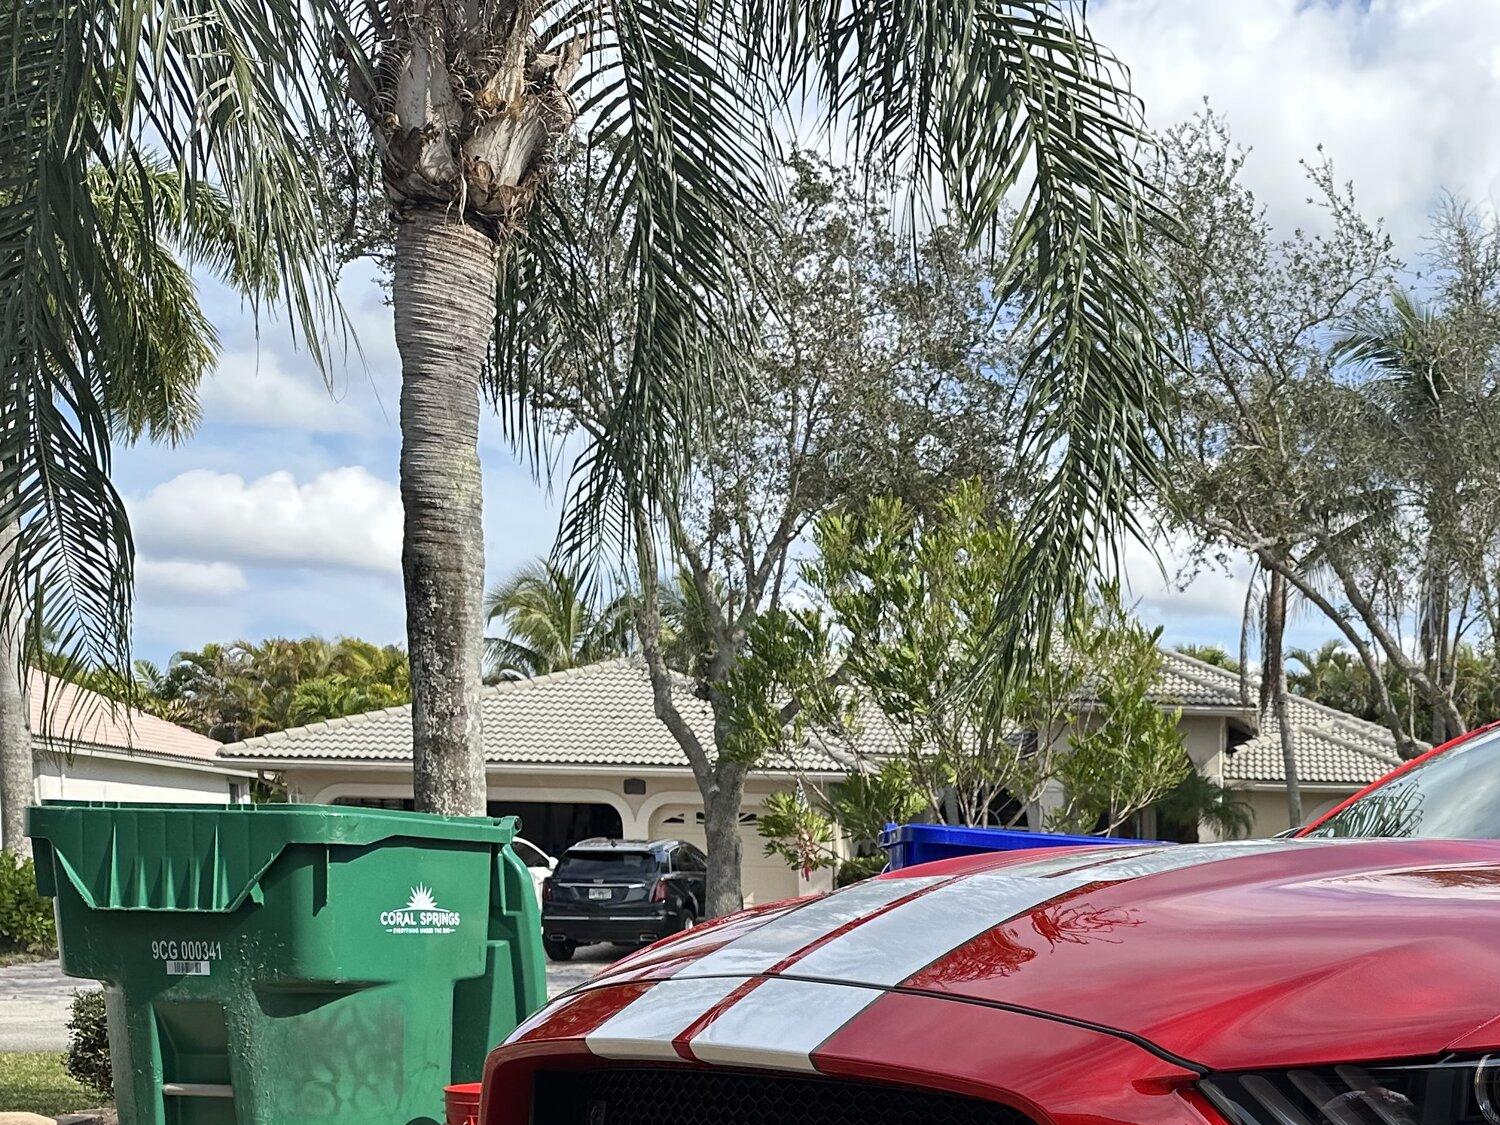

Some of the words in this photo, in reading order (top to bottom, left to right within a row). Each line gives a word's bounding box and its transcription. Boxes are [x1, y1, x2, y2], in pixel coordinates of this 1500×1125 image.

[380, 911, 417, 927] CORAL
[419, 911, 460, 927] SPRINGS
[151, 940, 178, 960] 9CG
[181, 940, 222, 960] 000341
